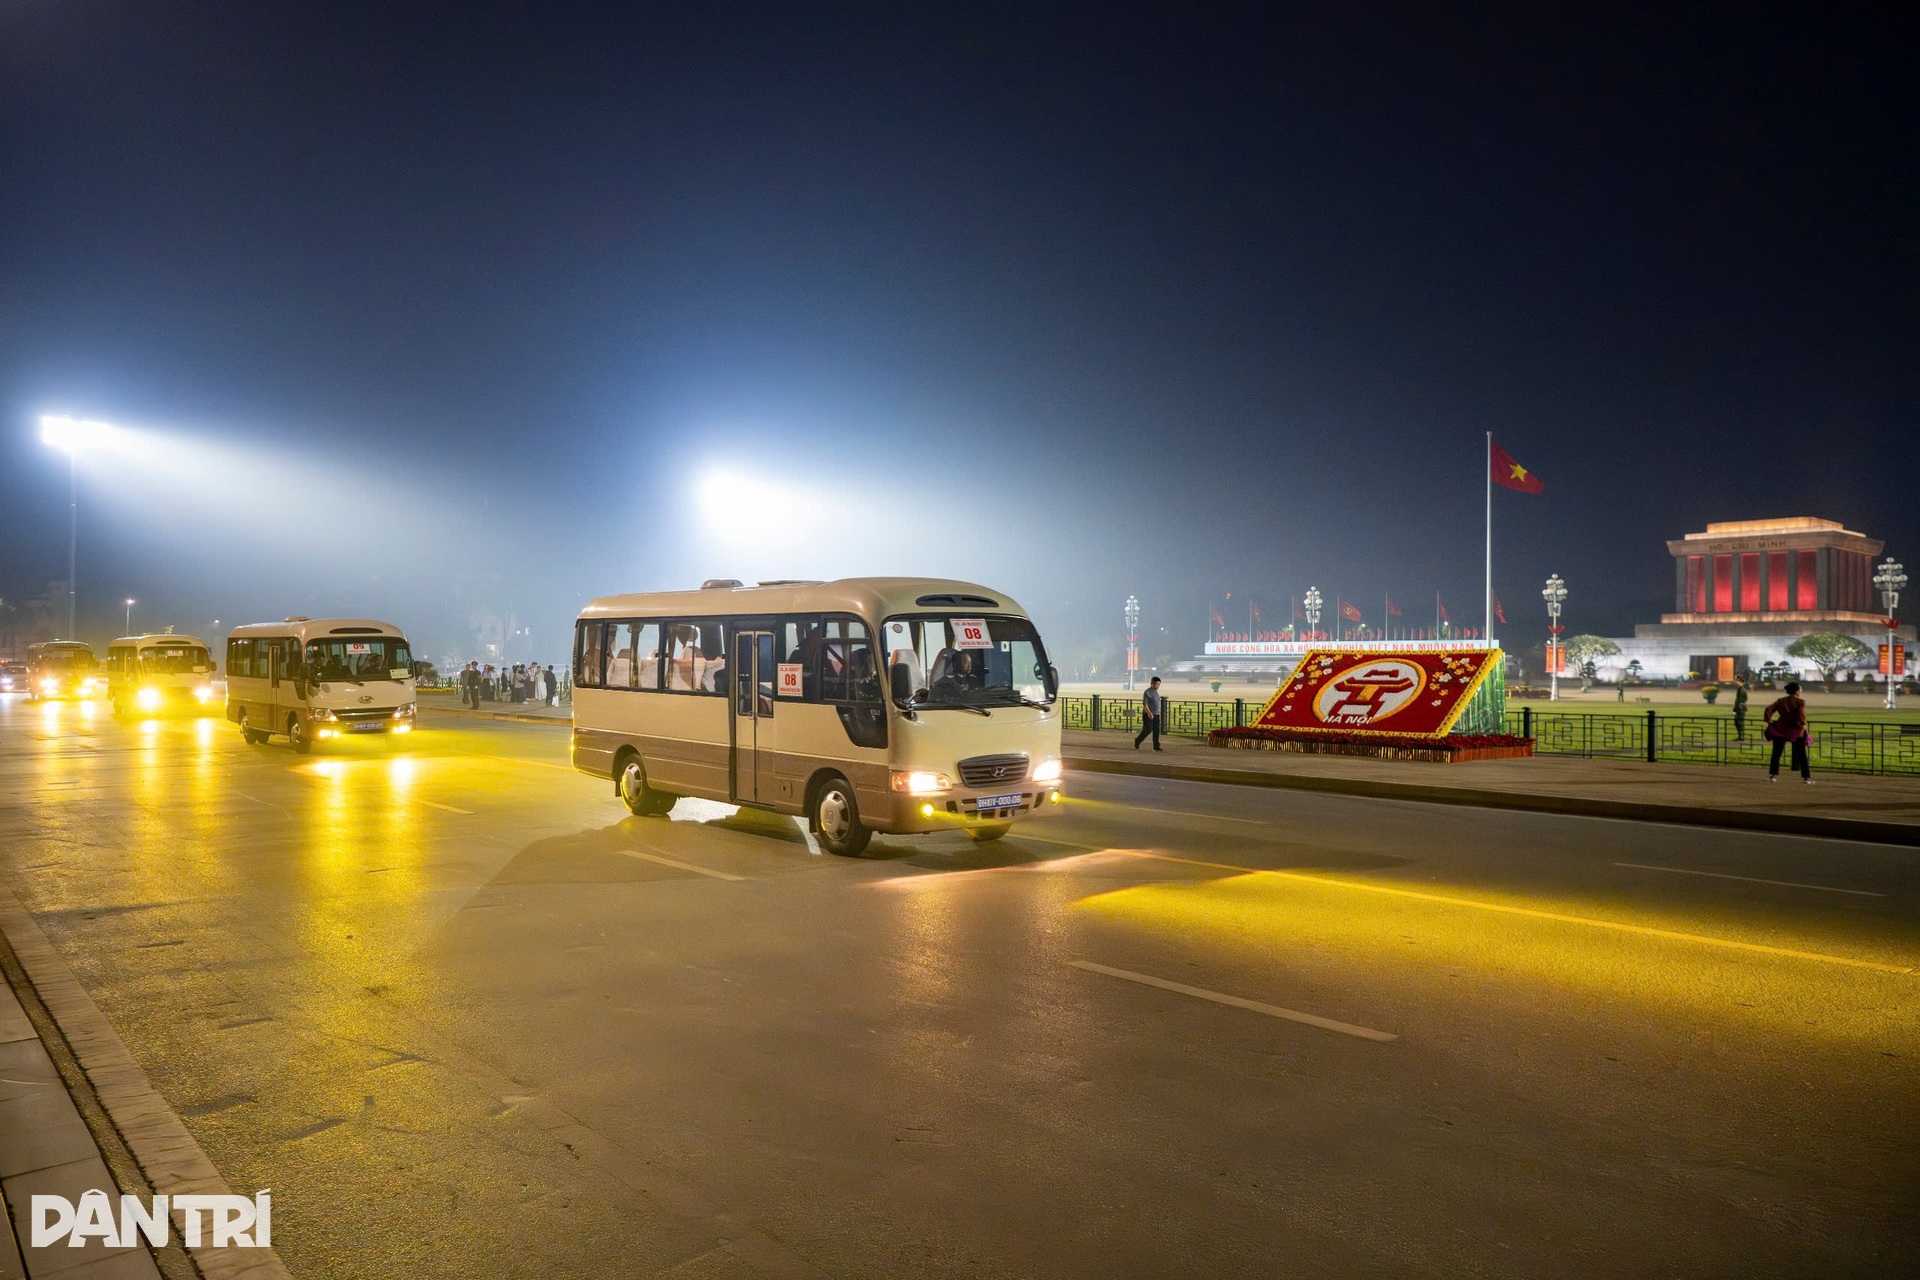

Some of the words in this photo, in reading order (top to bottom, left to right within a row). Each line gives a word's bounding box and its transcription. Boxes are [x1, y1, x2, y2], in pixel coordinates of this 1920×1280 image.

[964, 628, 982, 639] 08
[785, 674, 796, 685] 08
[1322, 714, 1343, 723] HÀ
[1345, 714, 1372, 726] NỘI
